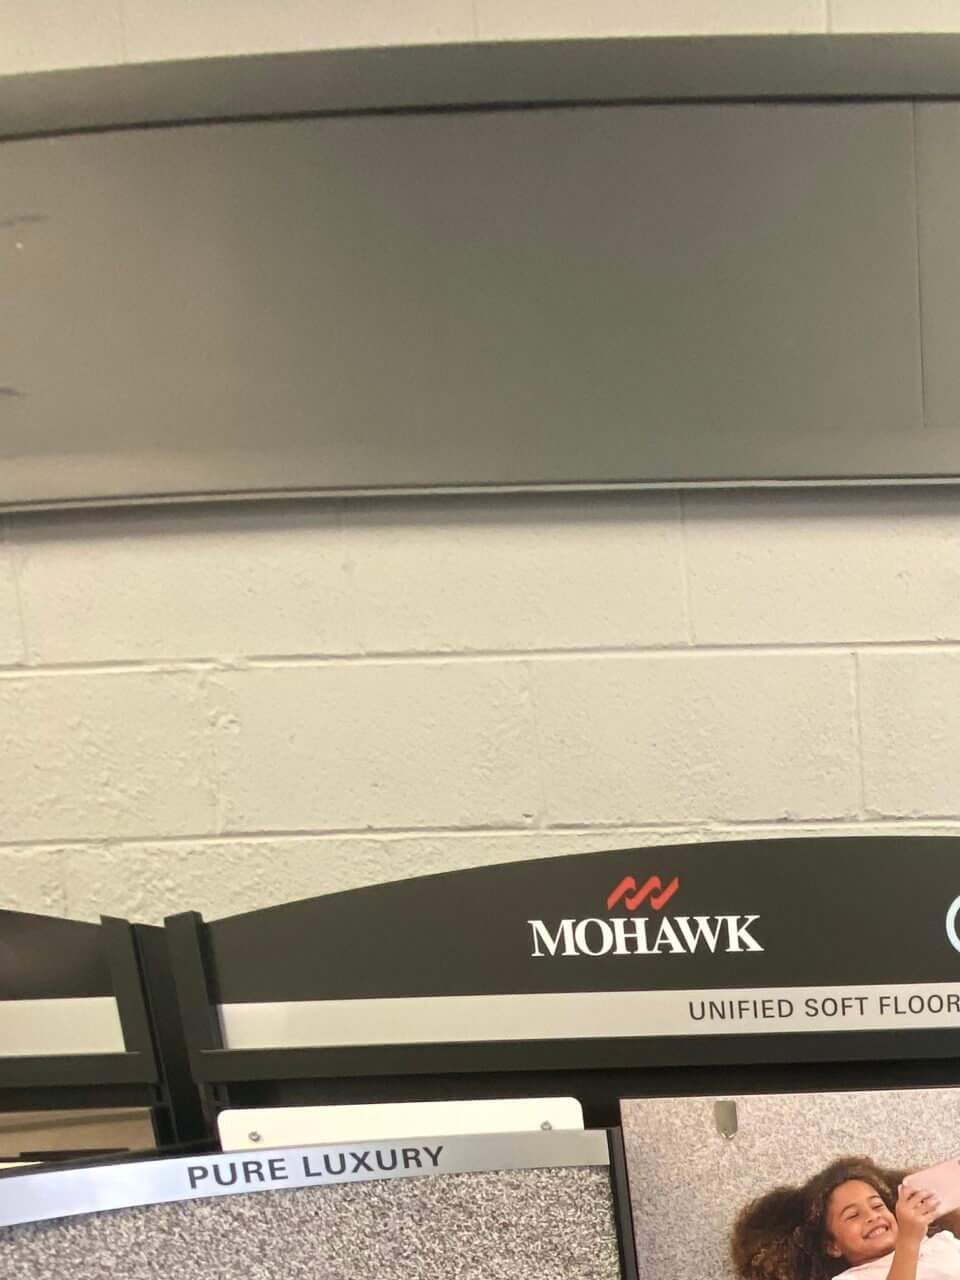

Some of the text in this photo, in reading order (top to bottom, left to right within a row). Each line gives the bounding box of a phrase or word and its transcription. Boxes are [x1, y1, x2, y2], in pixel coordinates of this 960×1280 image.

[527, 913, 764, 958] MOHAWK
[688, 998, 795, 1021] UNIFIED
[804, 996, 870, 1018] SOFT
[187, 1146, 444, 1190] PURE LUXURY
